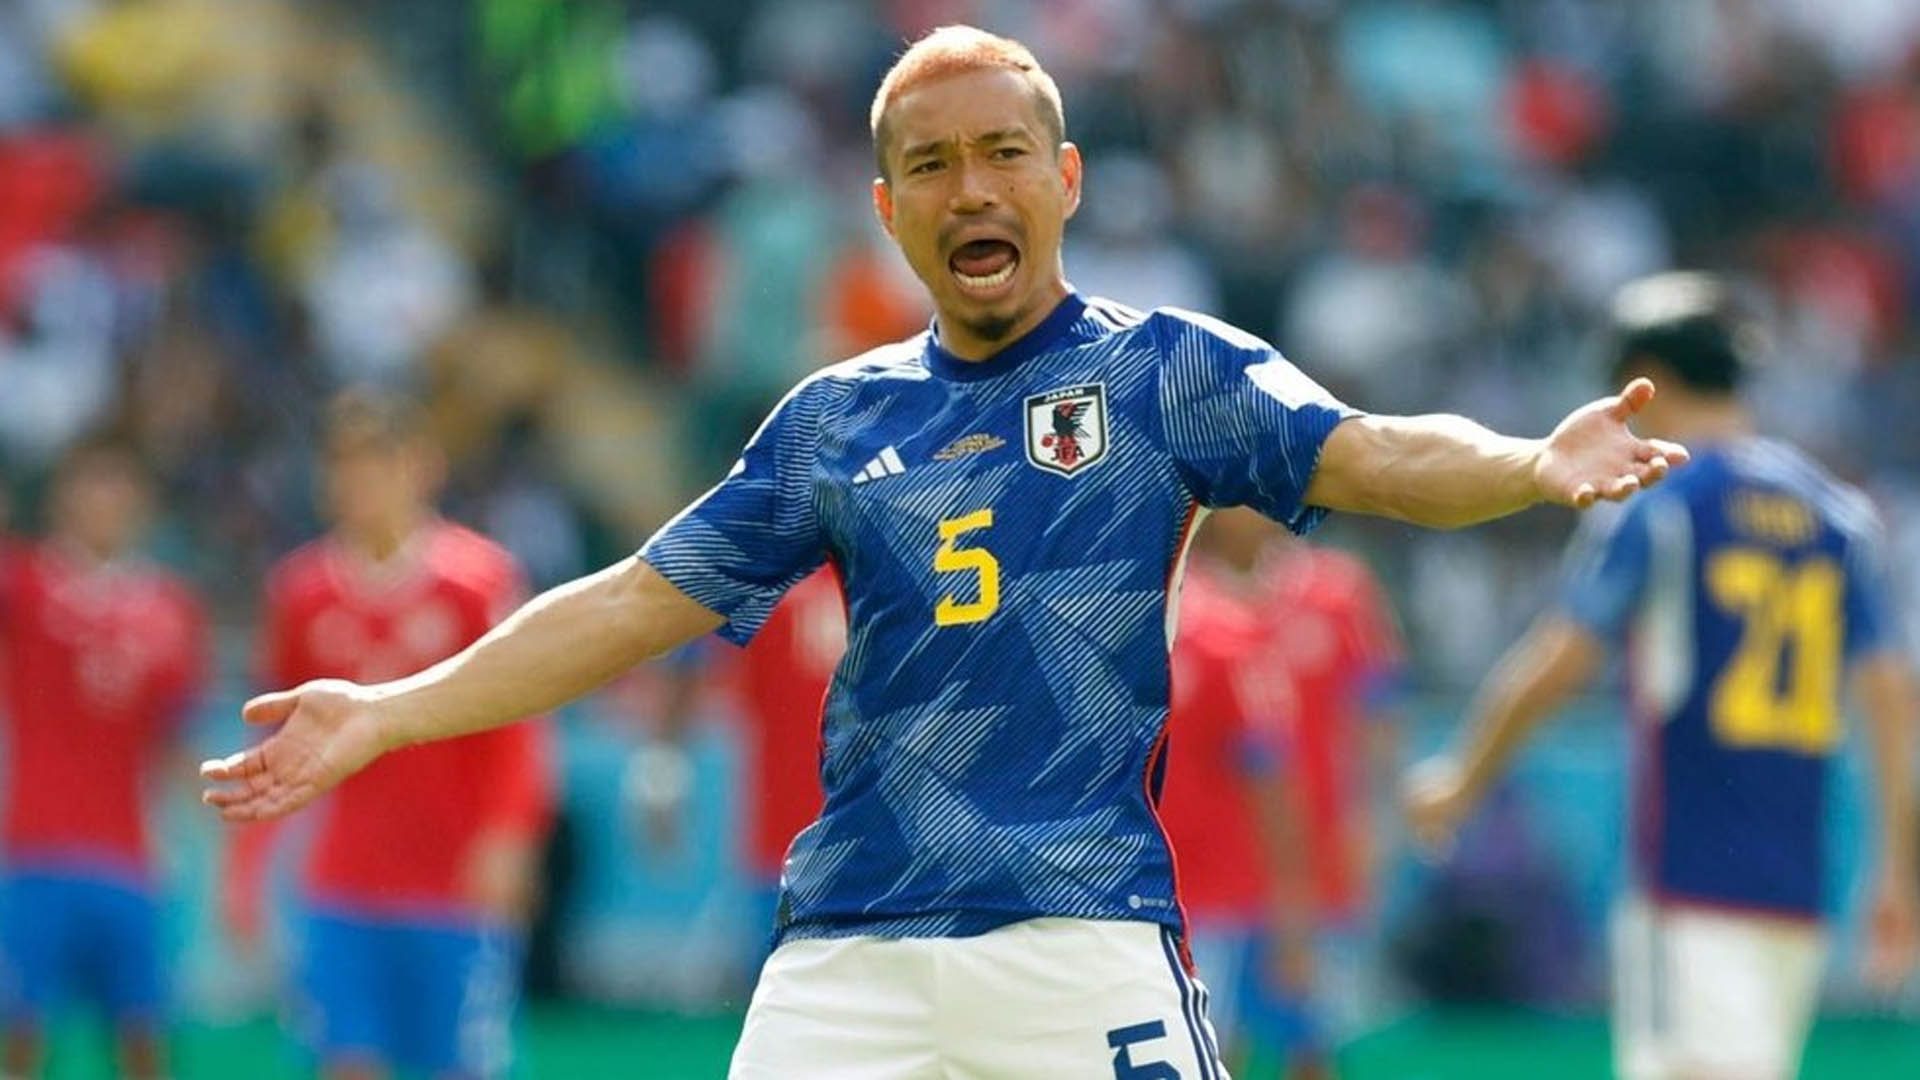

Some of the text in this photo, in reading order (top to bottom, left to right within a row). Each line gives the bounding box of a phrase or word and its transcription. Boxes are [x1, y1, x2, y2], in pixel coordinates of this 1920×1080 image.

[1050, 445, 1085, 462] JFA
[934, 507, 999, 626] 5
[1708, 551, 1840, 752] 21
[1106, 1019, 1182, 1080] 5
